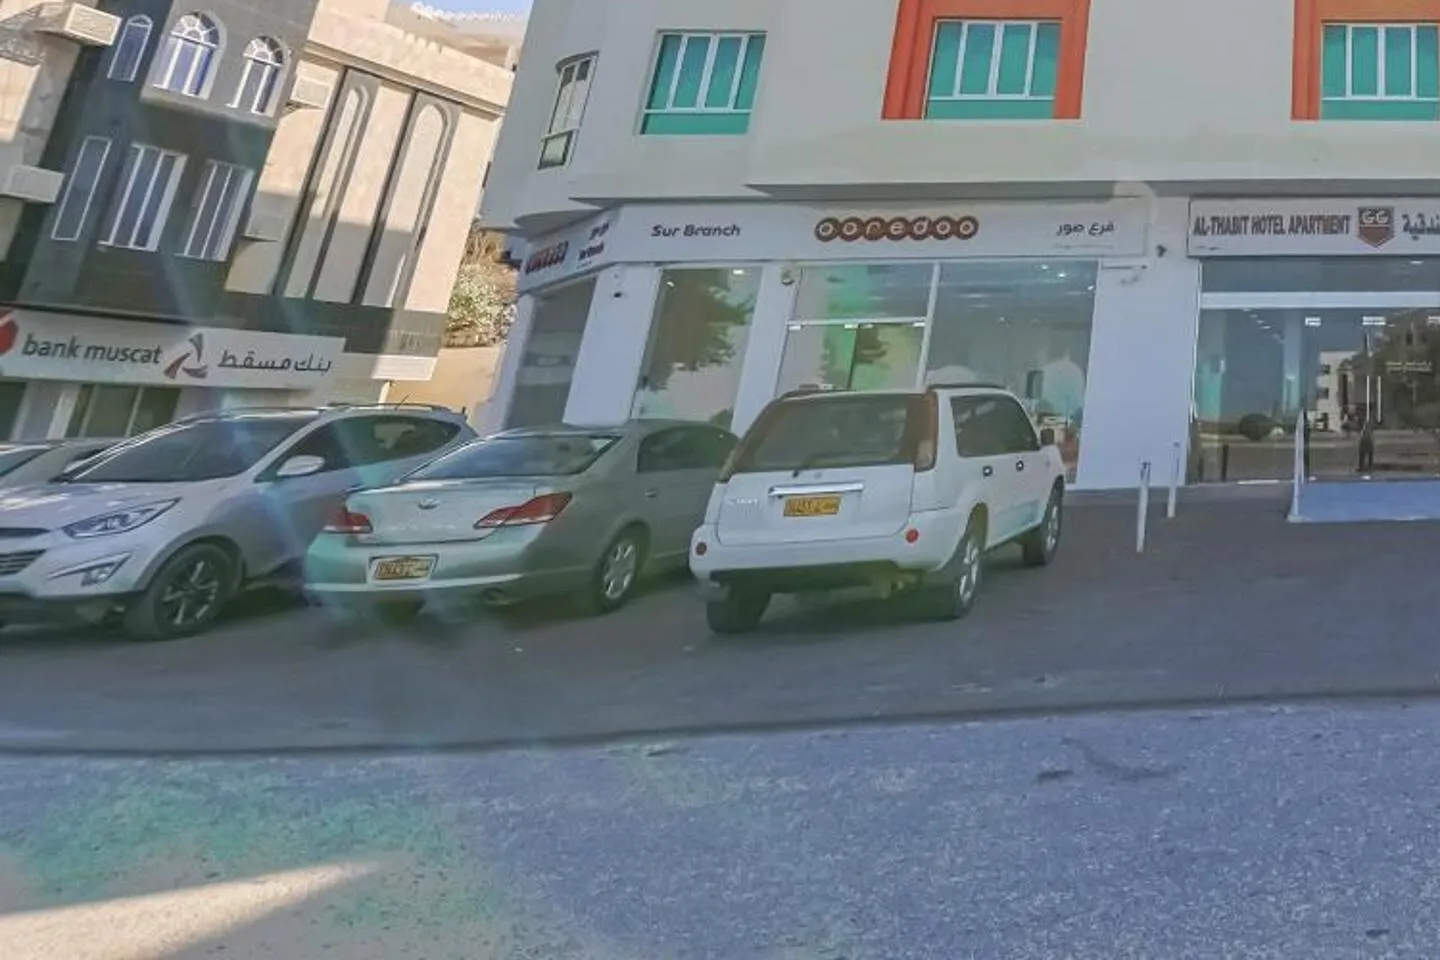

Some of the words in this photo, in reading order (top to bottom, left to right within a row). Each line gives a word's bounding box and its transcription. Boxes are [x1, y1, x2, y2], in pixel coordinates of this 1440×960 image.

[651, 223, 680, 238] Sur
[682, 223, 742, 238] Branch
[816, 216, 978, 241] ooredoo
[1056, 223, 1085, 237] صور
[1087, 221, 1115, 236] فرع
[1193, 215, 1250, 236] AL-THABIT
[1251, 214, 1285, 235] HOTEL
[1287, 214, 1352, 235] APARTMENT
[21, 332, 81, 359] bank
[83, 343, 163, 364] muscat
[217, 349, 292, 370] مسقط
[294, 353, 332, 377] بنك
